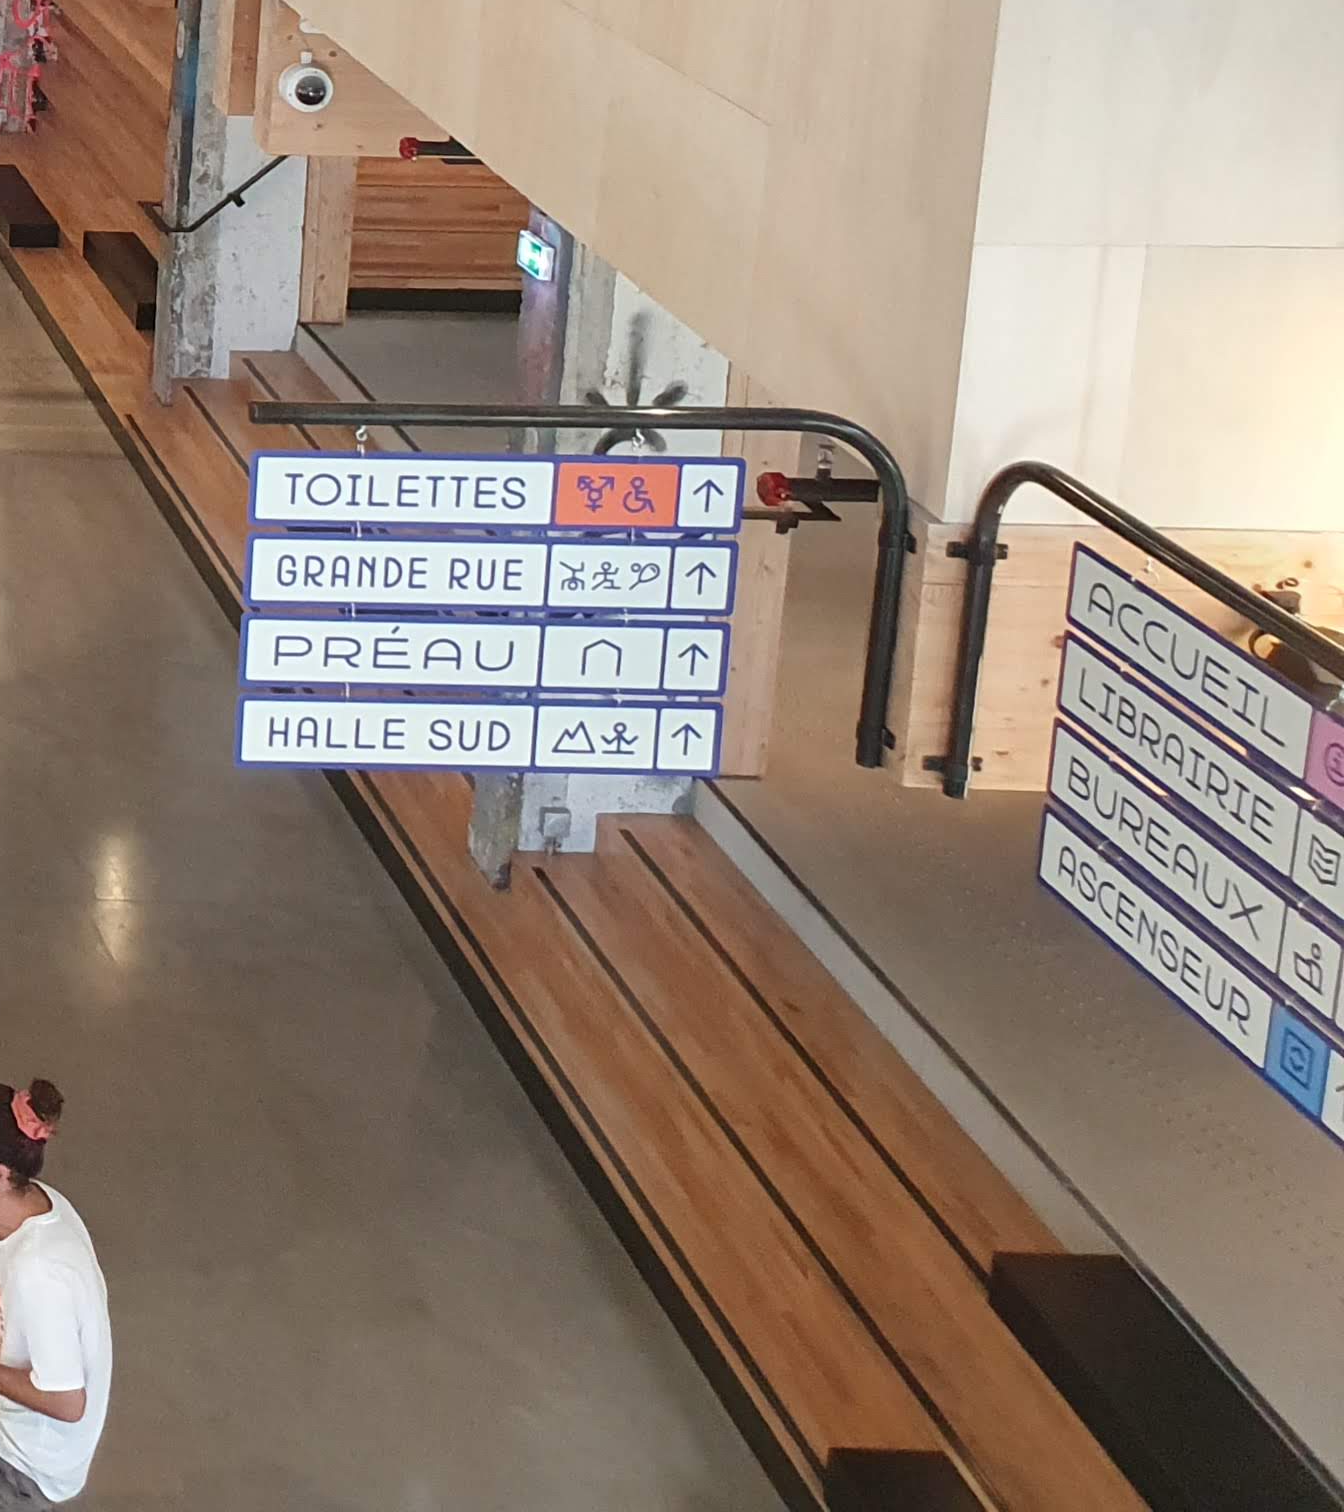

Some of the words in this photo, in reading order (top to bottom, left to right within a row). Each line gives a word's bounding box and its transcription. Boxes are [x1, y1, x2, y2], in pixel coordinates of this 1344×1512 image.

[285, 472, 526, 509] TOILETTES
[276, 554, 428, 589] GRANDE
[448, 558, 523, 591] RUE
[273, 626, 514, 671] PRÉAU
[1088, 582, 1285, 747] ACCUEIL
[268, 716, 405, 749] HALLE
[427, 720, 511, 751] SUD
[1079, 667, 1273, 844] LIBRAIRIE
[1067, 755, 1263, 941] BUREAUX
[1057, 845, 1251, 1036] ASCENSEUR
